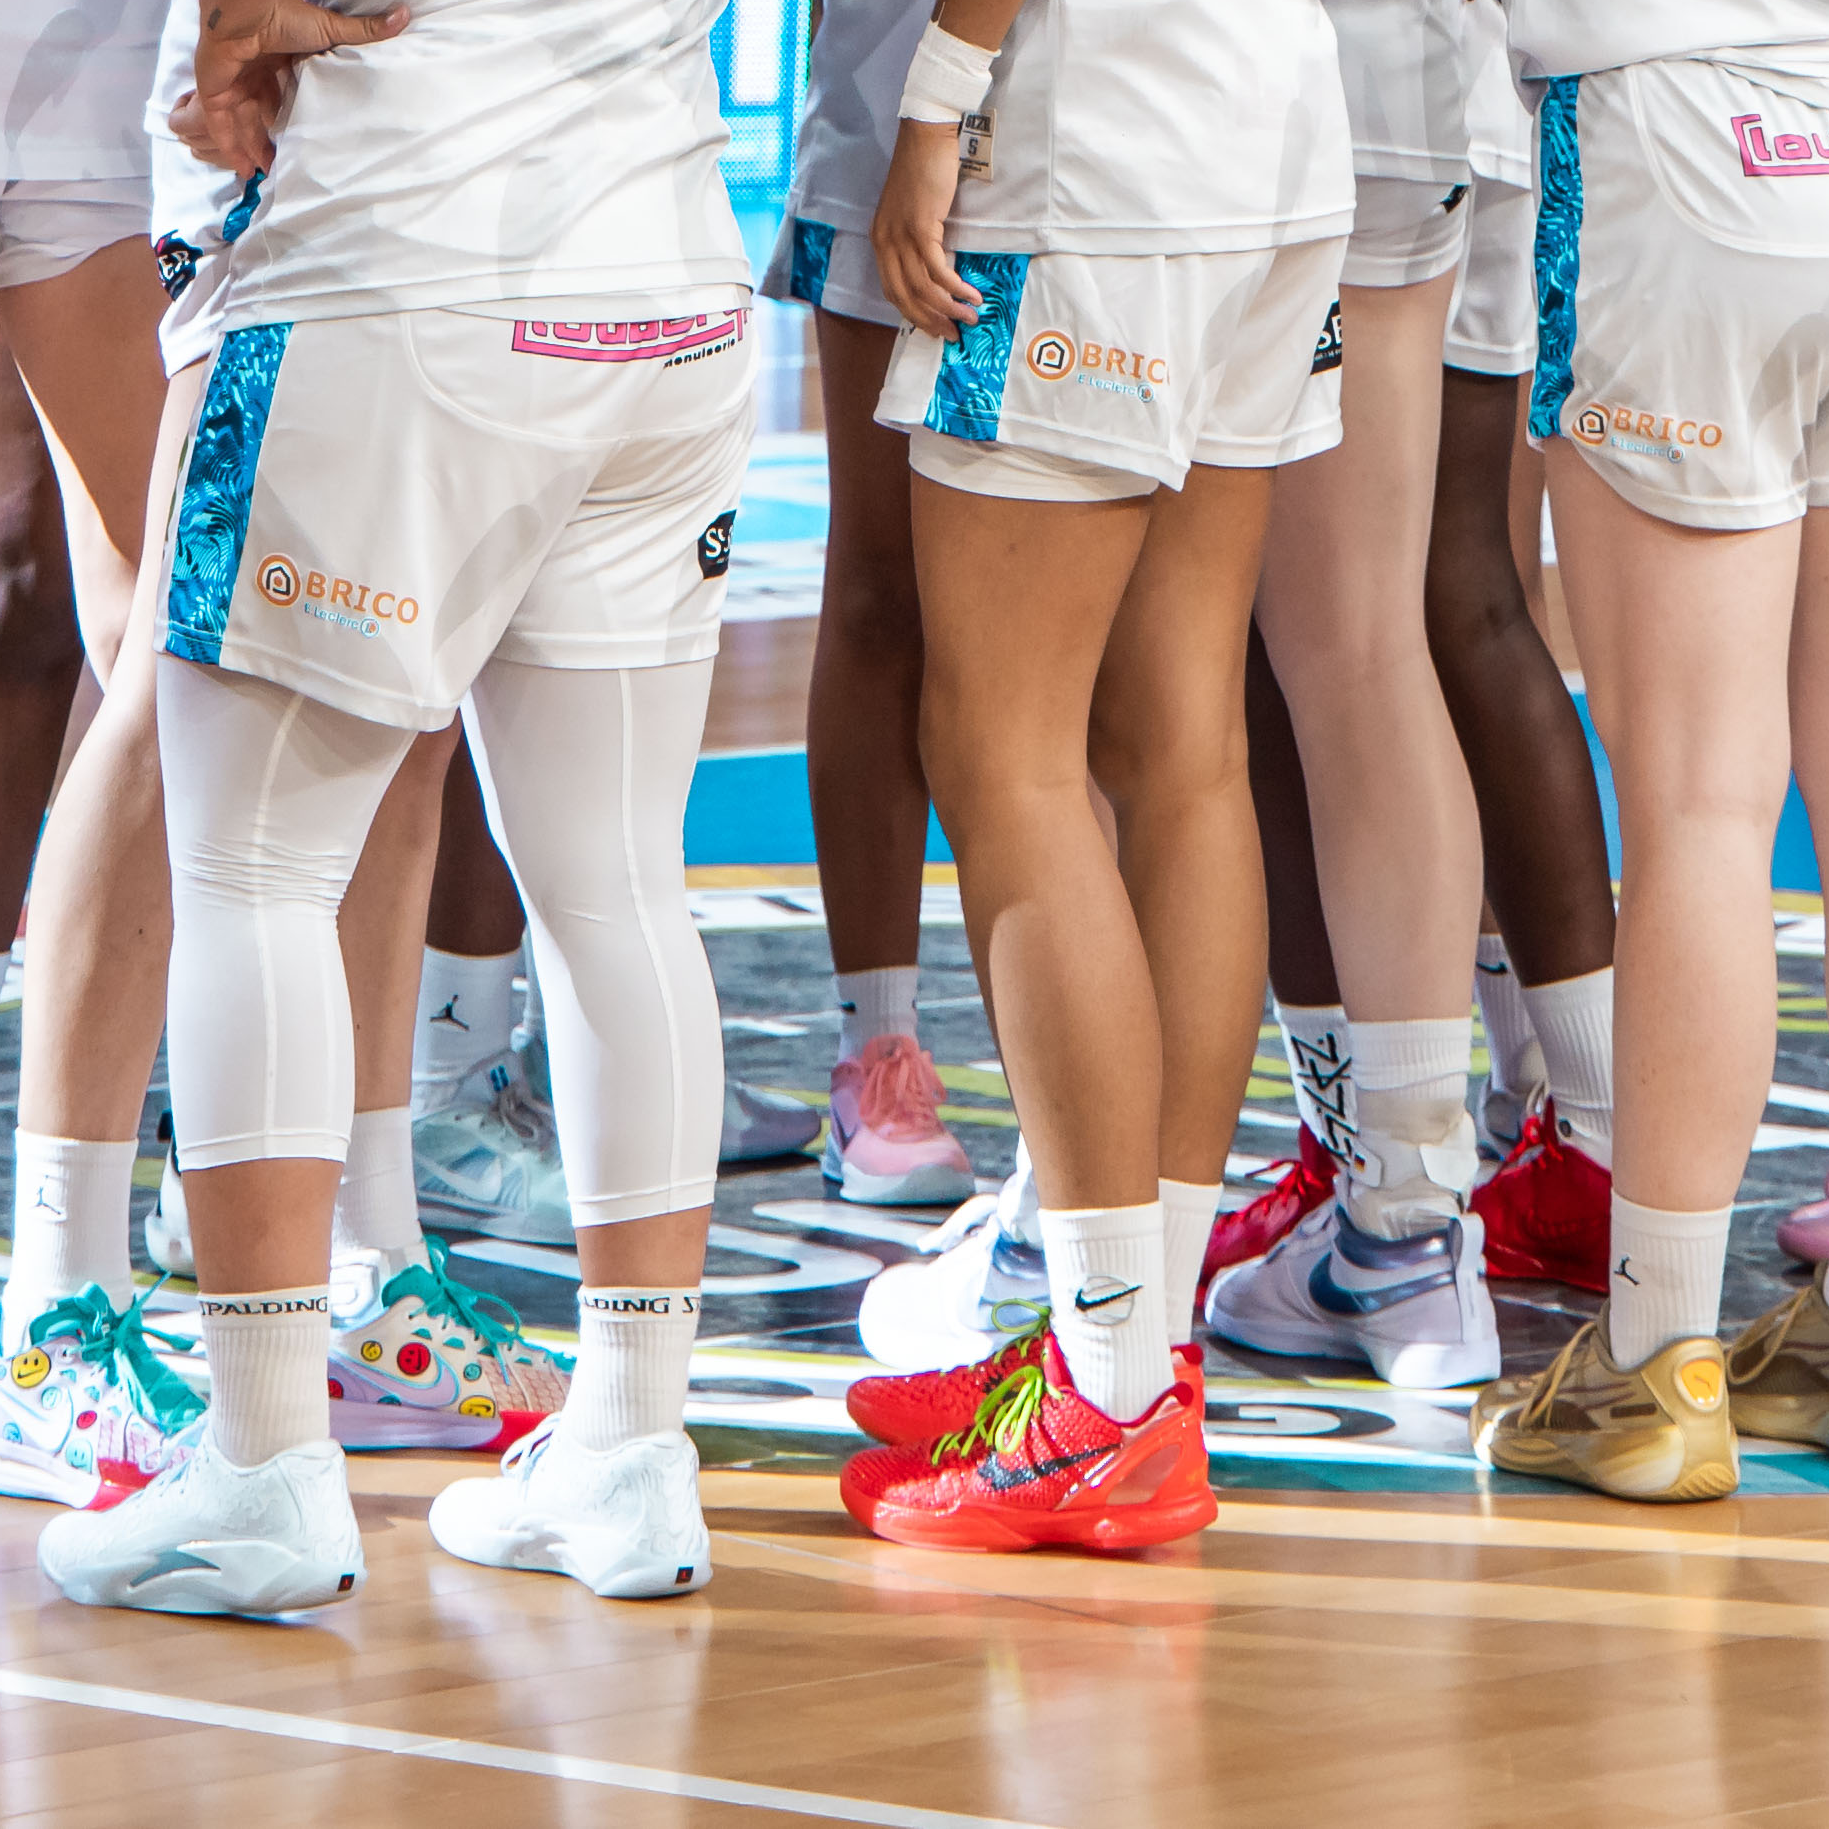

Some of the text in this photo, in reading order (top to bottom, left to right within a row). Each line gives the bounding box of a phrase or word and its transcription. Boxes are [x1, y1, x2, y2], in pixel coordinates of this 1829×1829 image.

[1081, 341, 1170, 385] BRIC
[1613, 406, 1723, 448] BRICO
[305, 570, 420, 625] BRICO
